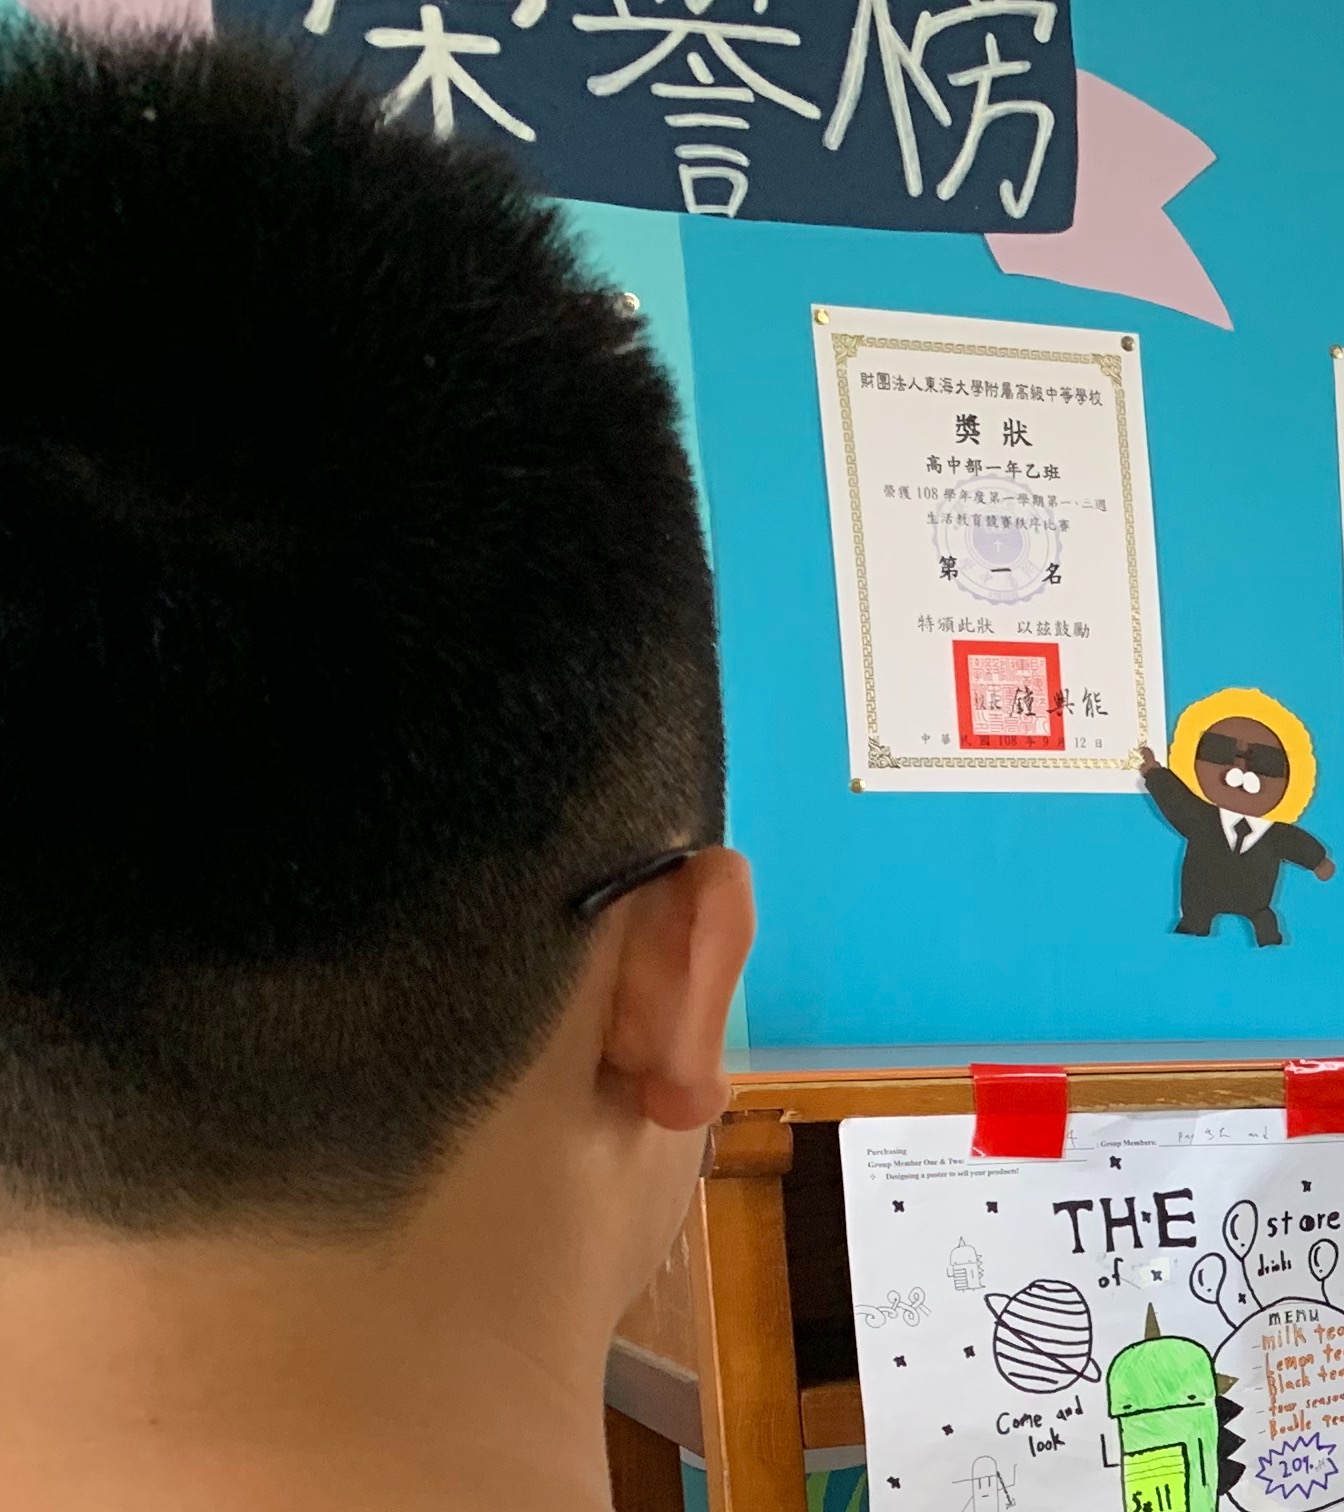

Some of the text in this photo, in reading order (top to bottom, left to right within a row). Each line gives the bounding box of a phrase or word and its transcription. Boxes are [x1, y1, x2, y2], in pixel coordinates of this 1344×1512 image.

[860, 371, 1103, 406] 財團法人東海大學附屬高級中等學校
[956, 414, 1033, 447] 獎狀
[926, 455, 1061, 481] 高中部一年乙班
[939, 556, 1062, 585] 第一名
[867, 1148, 908, 1157] Purchasing
[1100, 1138, 1157, 1149] Group Members:
[867, 1160, 892, 1170] Group
[893, 1158, 922, 1167] Member
[923, 1157, 938, 1166] One
[939, 1157, 946, 1166] &
[886, 1172, 920, 1181] Designing
[926, 1171, 948, 1180] poster
[949, 1170, 956, 1178] to
[957, 1169, 969, 1178] sell
[970, 1169, 986, 1179] your
[1053, 1188, 1341, 1253] THE store
[1098, 1257, 1123, 1288] of
[996, 1395, 1084, 1435] Come and
[1028, 1427, 1066, 1457] look
